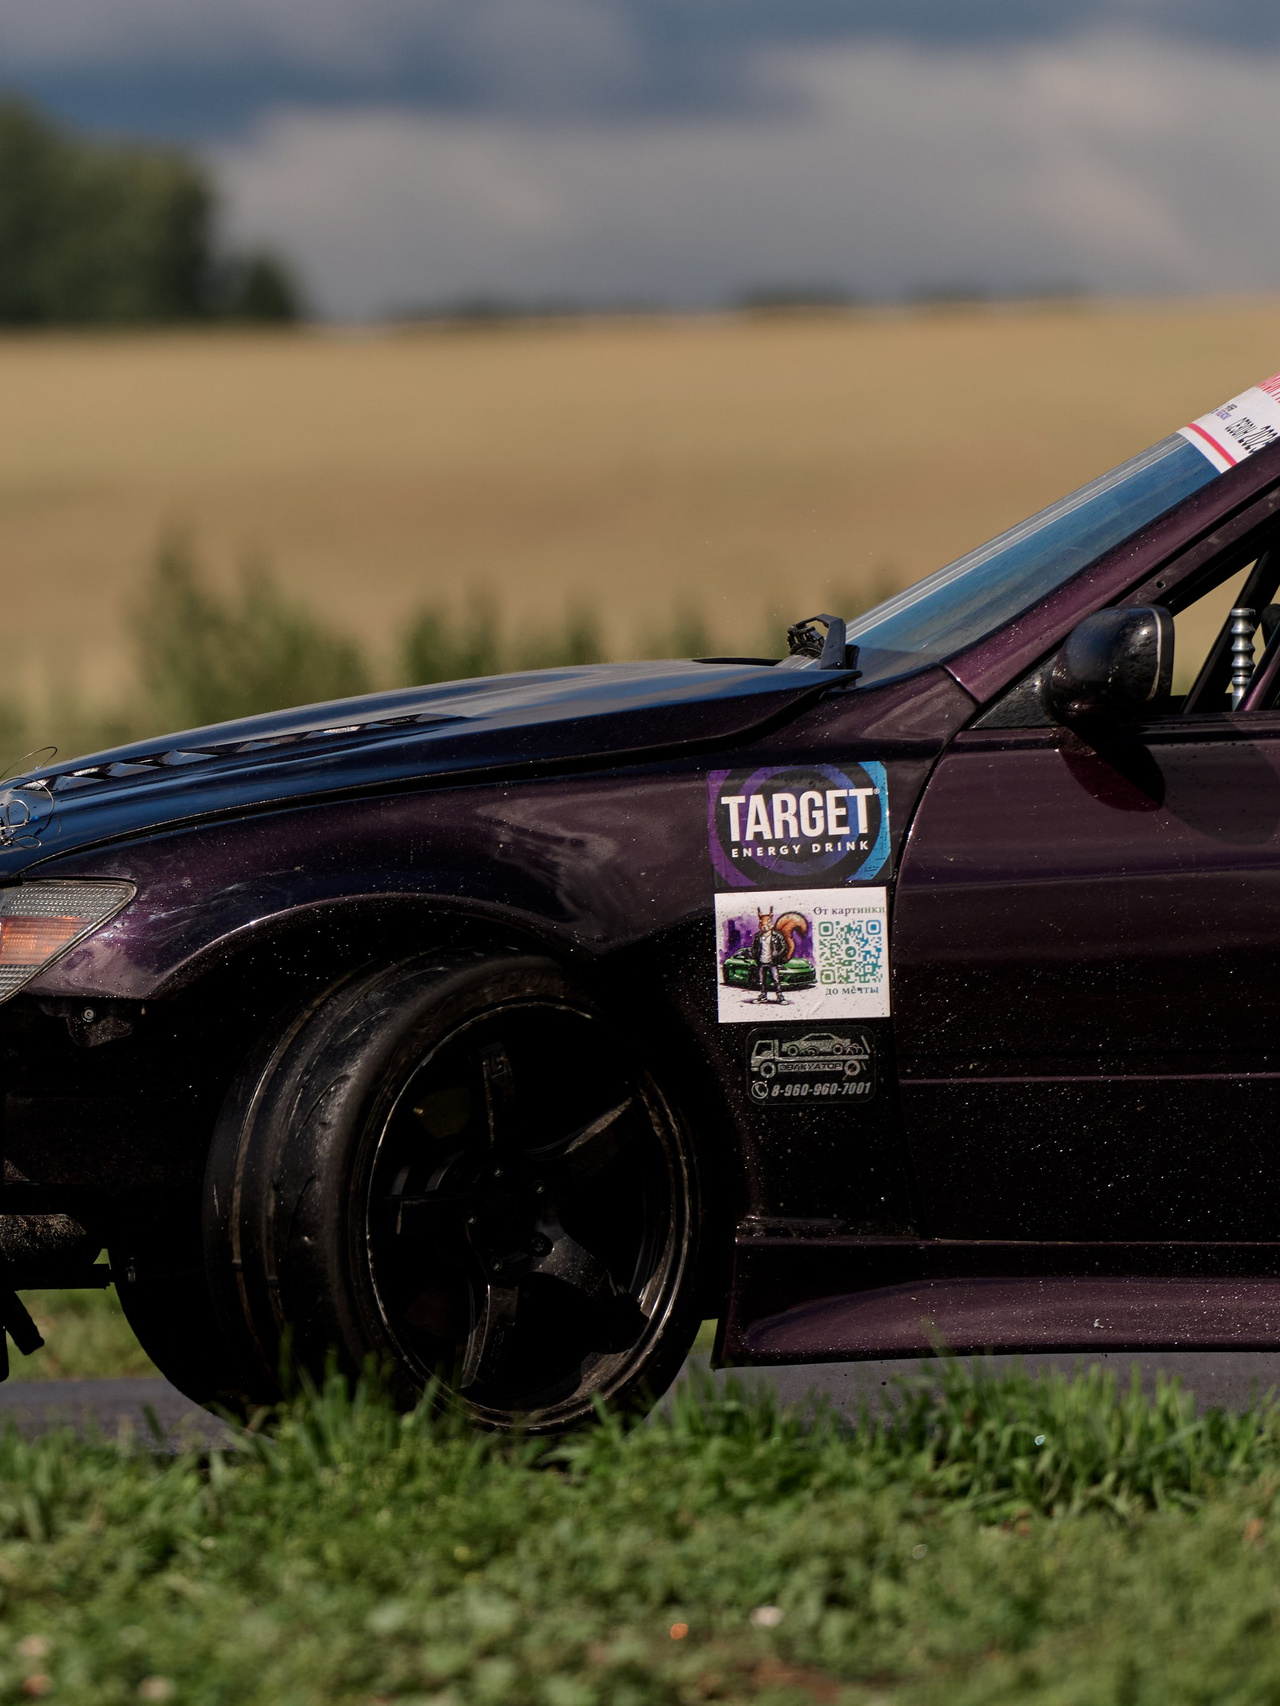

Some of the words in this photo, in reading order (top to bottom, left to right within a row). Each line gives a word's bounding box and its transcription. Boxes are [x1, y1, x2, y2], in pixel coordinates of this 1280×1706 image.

[721, 788, 874, 842] TARGET
[731, 844, 801, 858] ENERGY
[812, 840, 870, 853] DRINK
[813, 906, 829, 915] От
[831, 906, 886, 917] картинки
[825, 987, 839, 996] до
[842, 986, 879, 995] мечты
[779, 1062, 842, 1072] ЭВАКУАТОР
[771, 1082, 872, 1097] 8-960-960-7001
